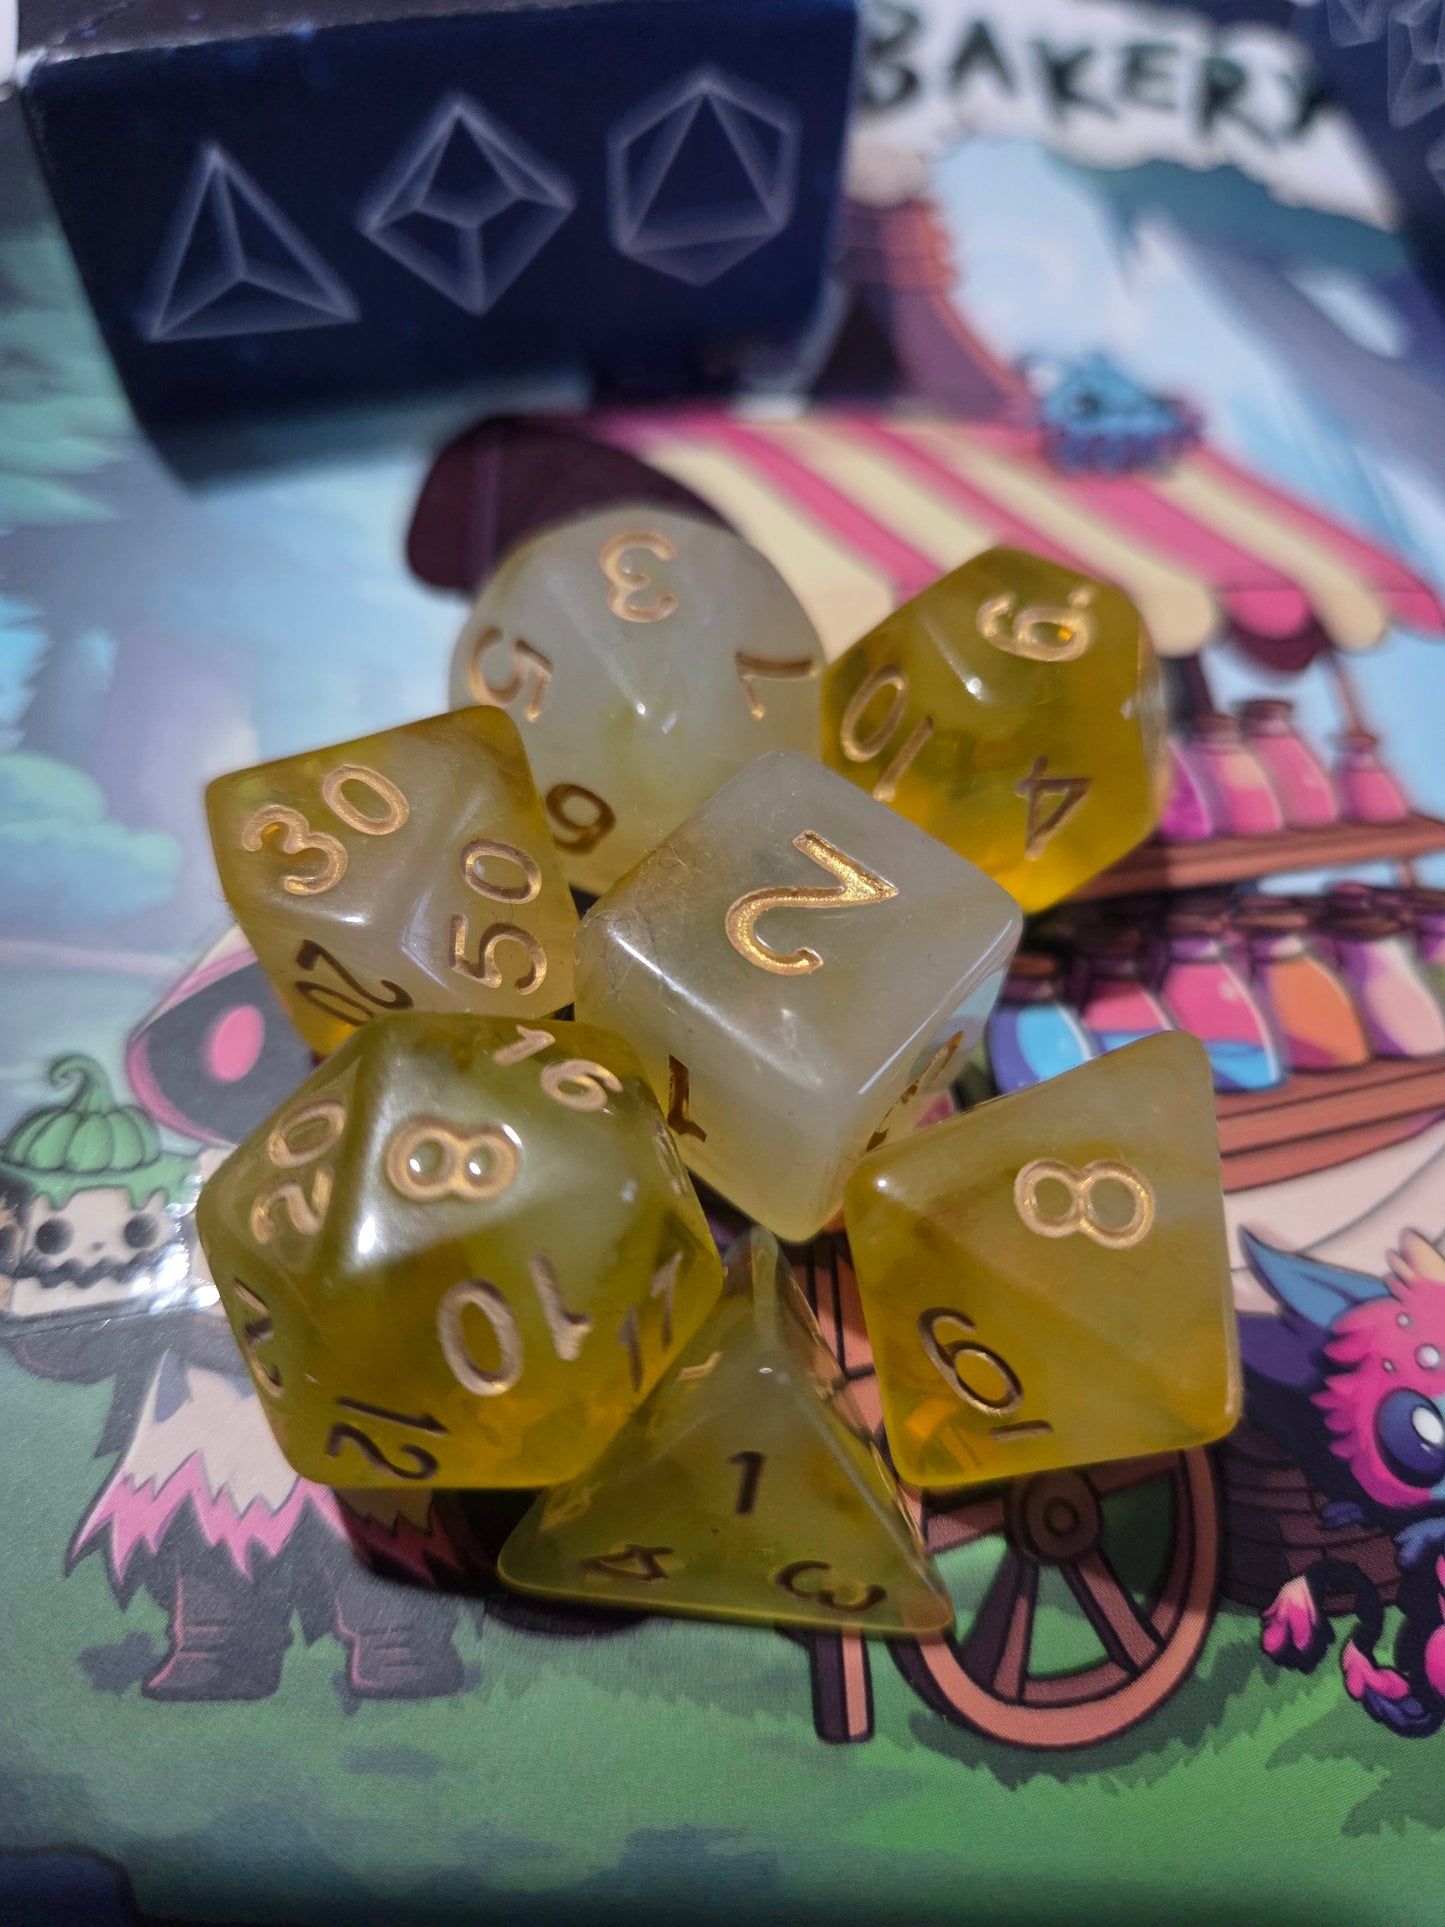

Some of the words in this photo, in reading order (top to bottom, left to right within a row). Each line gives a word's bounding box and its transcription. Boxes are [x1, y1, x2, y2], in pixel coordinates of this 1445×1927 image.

[468, 626, 554, 724] 5
[841, 662, 935, 803] 10
[241, 763, 411, 896] 30
[1014, 755, 1093, 862] 4
[450, 838, 548, 996] 50
[724, 829, 900, 976] 2
[493, 1024, 624, 1112] 16
[251, 1099, 346, 1245] 20
[387, 1116, 520, 1202] 8
[1014, 1158, 1156, 1250] 8
[437, 1250, 595, 1399] 10
[326, 1396, 450, 1481] 12
[728, 1450, 765, 1516] 1
